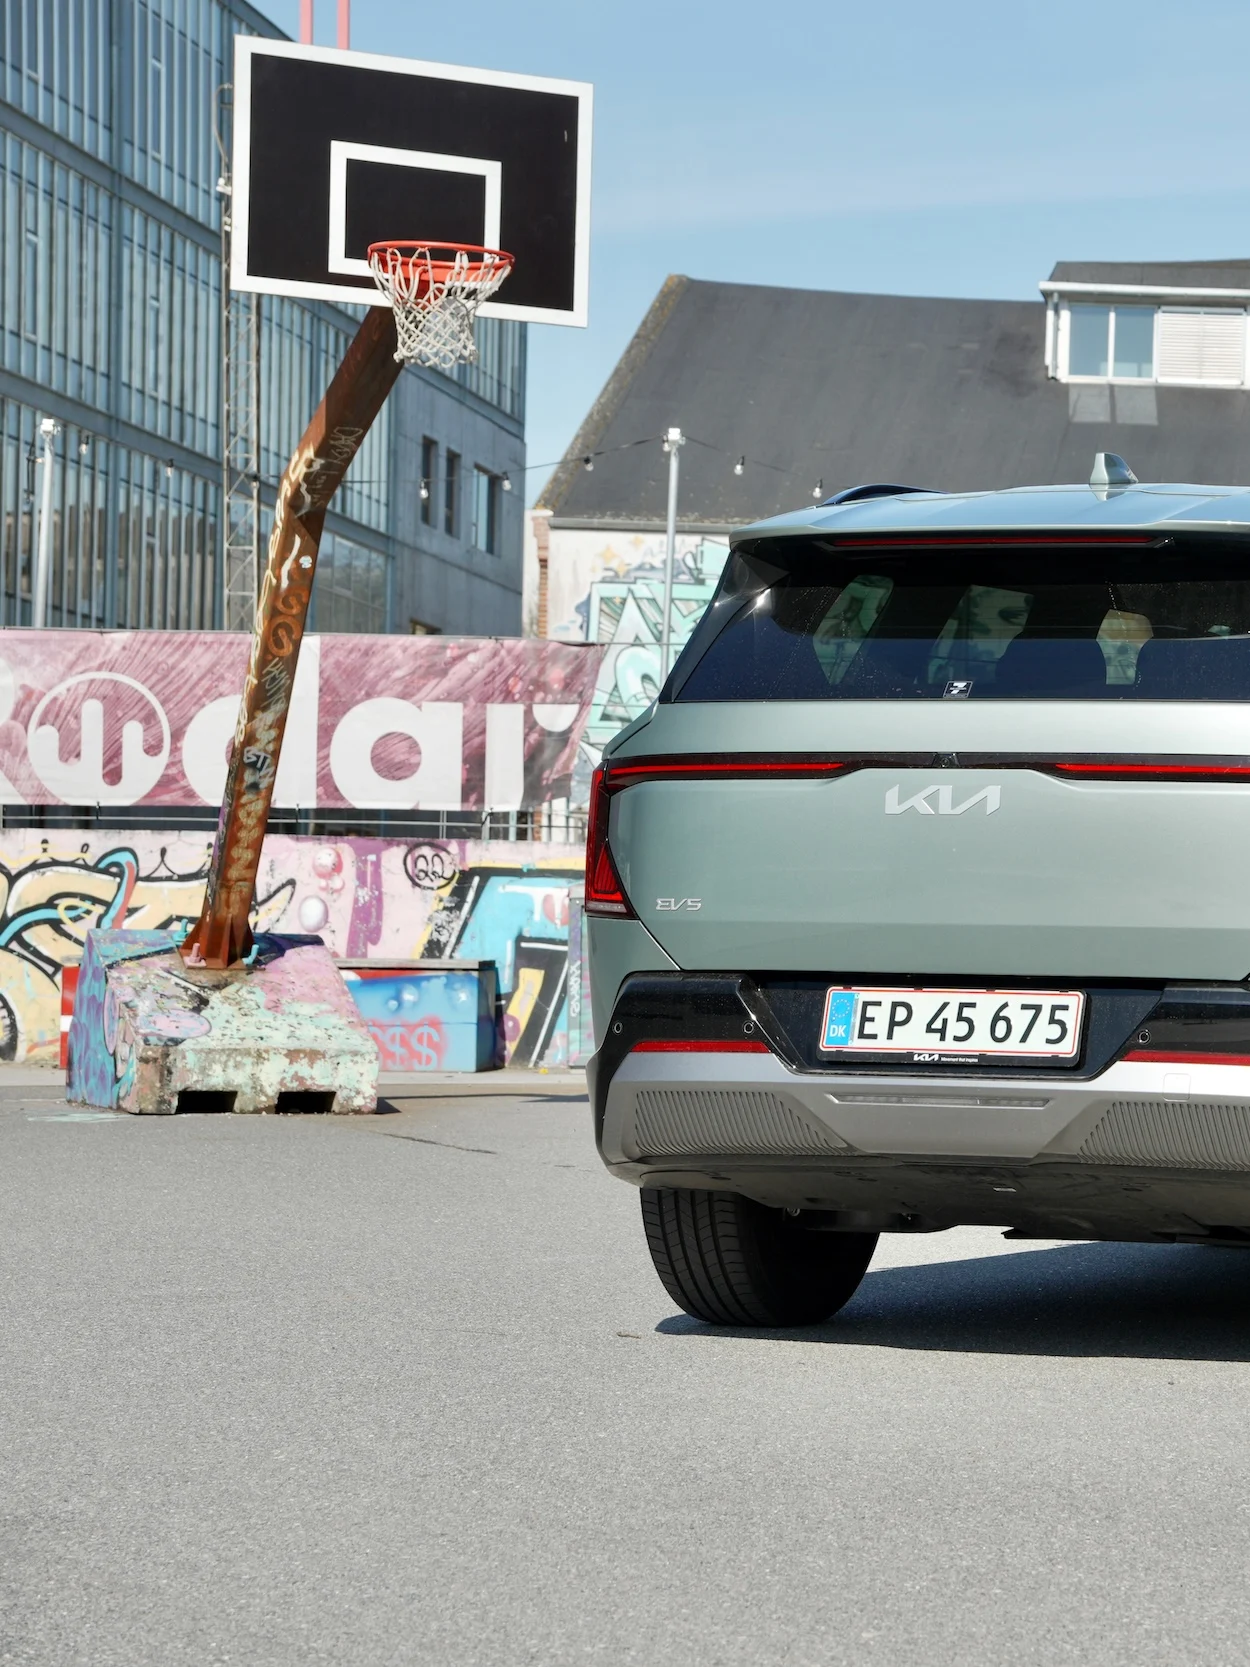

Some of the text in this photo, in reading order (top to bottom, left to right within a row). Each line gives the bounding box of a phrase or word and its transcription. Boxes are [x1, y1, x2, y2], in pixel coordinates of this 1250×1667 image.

[885, 784, 1001, 816] KIA
[656, 898, 702, 911] EV5
[829, 1025, 846, 1038] DK
[857, 1001, 913, 1041] EP
[925, 1001, 977, 1042] 45
[989, 1001, 1069, 1045] 675
[913, 1053, 939, 1062] KIA
